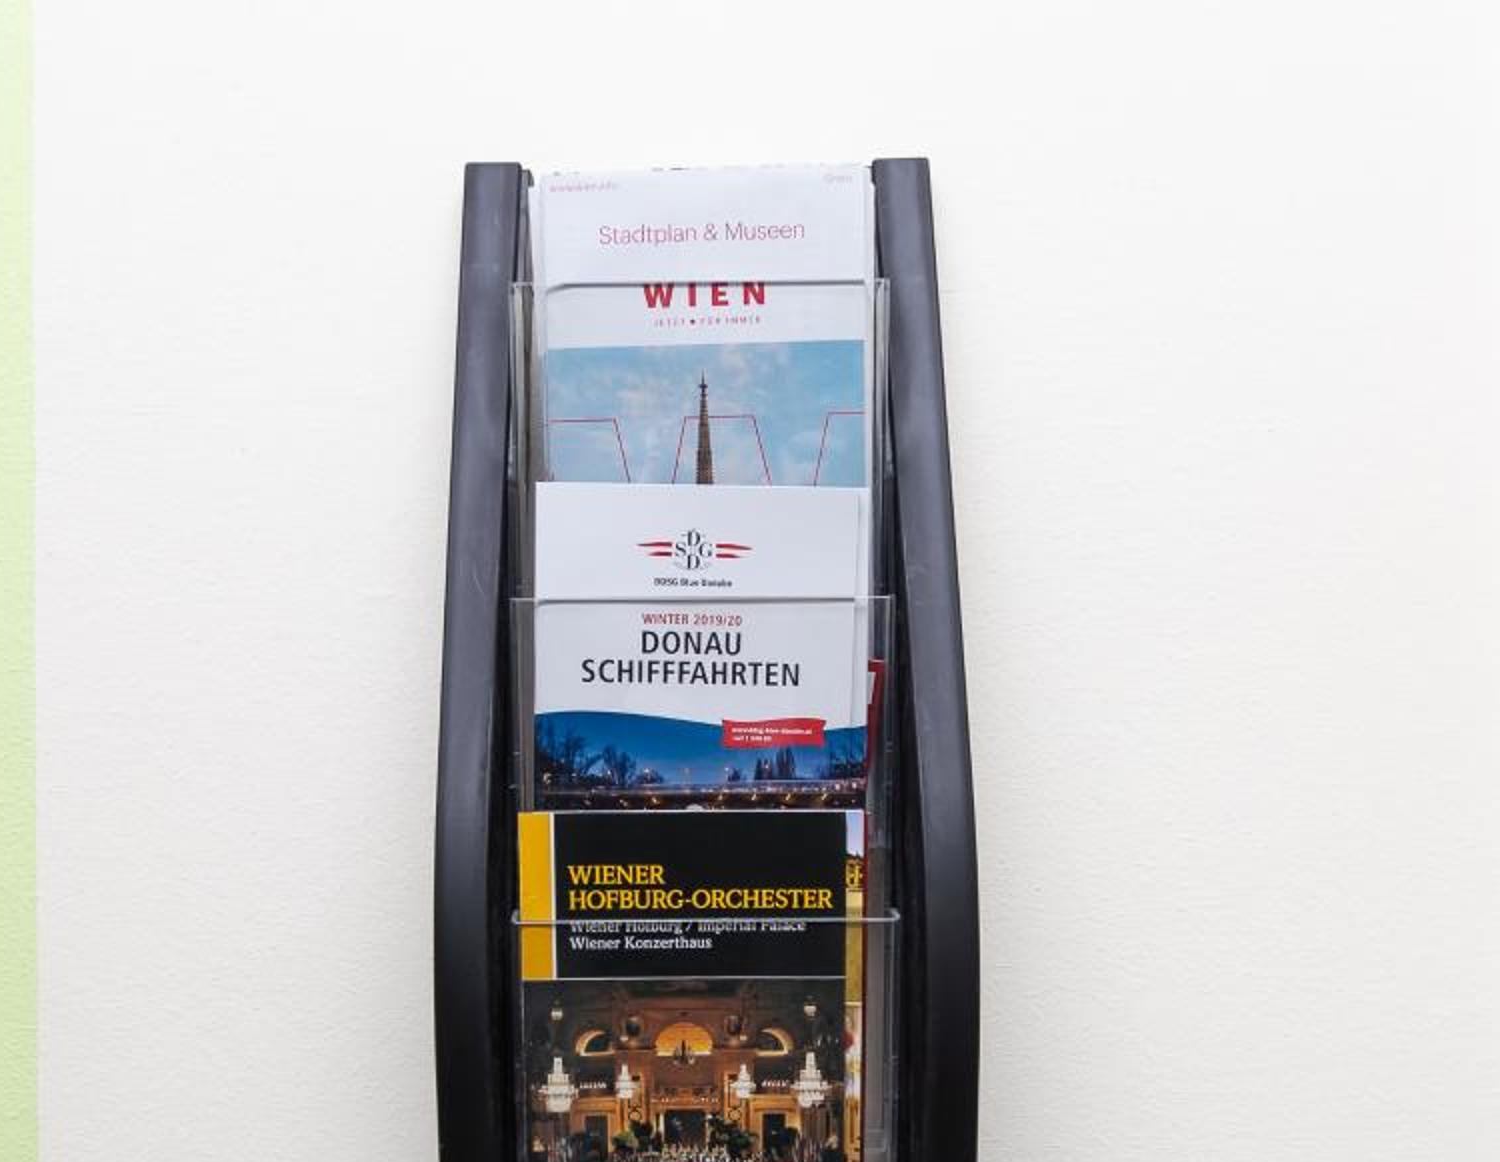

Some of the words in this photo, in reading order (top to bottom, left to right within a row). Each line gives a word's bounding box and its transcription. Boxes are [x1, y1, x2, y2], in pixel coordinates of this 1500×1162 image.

[598, 223, 698, 247] Stadtplan
[702, 222, 718, 242] &
[724, 221, 805, 241] Museen
[642, 281, 766, 309] WIEN
[641, 612, 690, 626] WINTER
[692, 613, 743, 628] 2019/20
[640, 630, 743, 656] DONAU
[580, 658, 801, 688] SCHIFFFAHRTEN
[567, 864, 665, 886] WIENER
[568, 889, 834, 912] HOFBURG-ORCHESTER
[569, 936, 621, 949] Wiener
[624, 935, 713, 949] Konzerthaus
